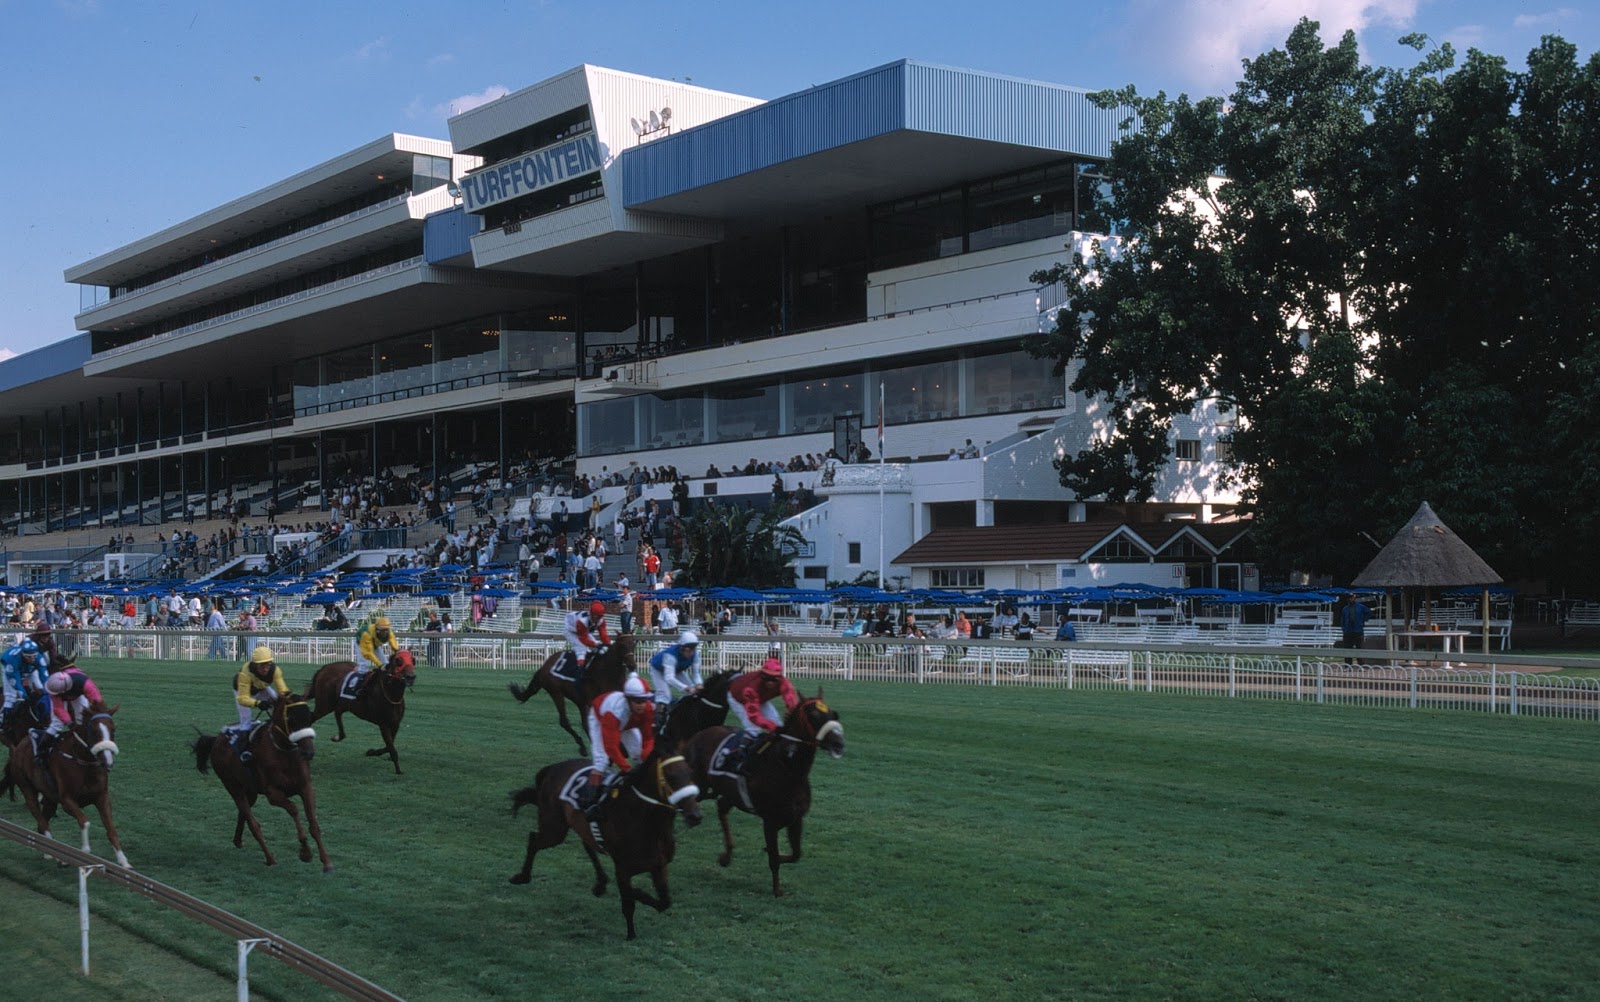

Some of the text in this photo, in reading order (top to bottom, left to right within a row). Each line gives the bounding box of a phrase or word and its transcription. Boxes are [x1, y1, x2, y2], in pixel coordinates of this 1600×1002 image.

[460, 133, 602, 208] TURFFONTEIN
[1174, 566, 1183, 577] IN
[569, 775, 588, 799] 2
